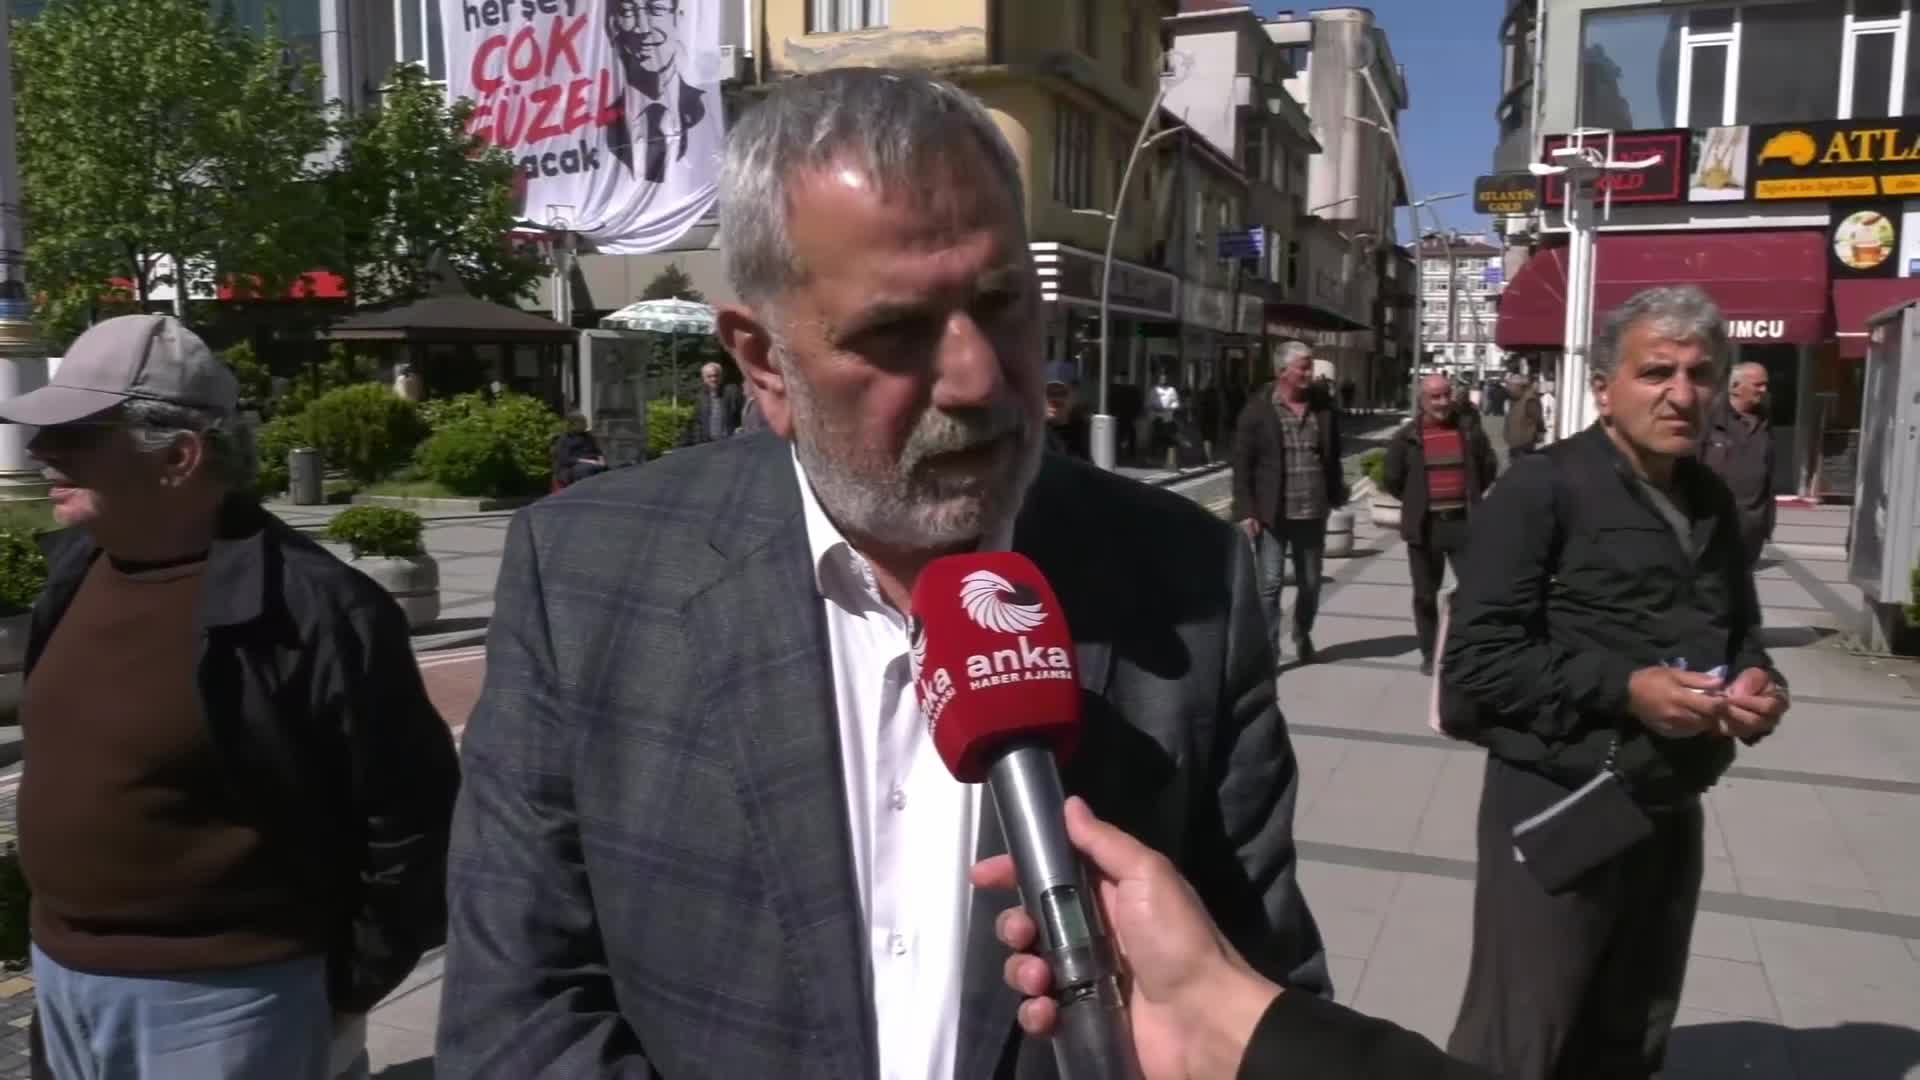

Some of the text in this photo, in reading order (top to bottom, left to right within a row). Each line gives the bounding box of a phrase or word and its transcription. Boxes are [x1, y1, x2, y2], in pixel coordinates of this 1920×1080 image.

[471, 14, 588, 99] ÇOK
[966, 636, 1071, 678] anka
[968, 673, 1022, 691] HABER
